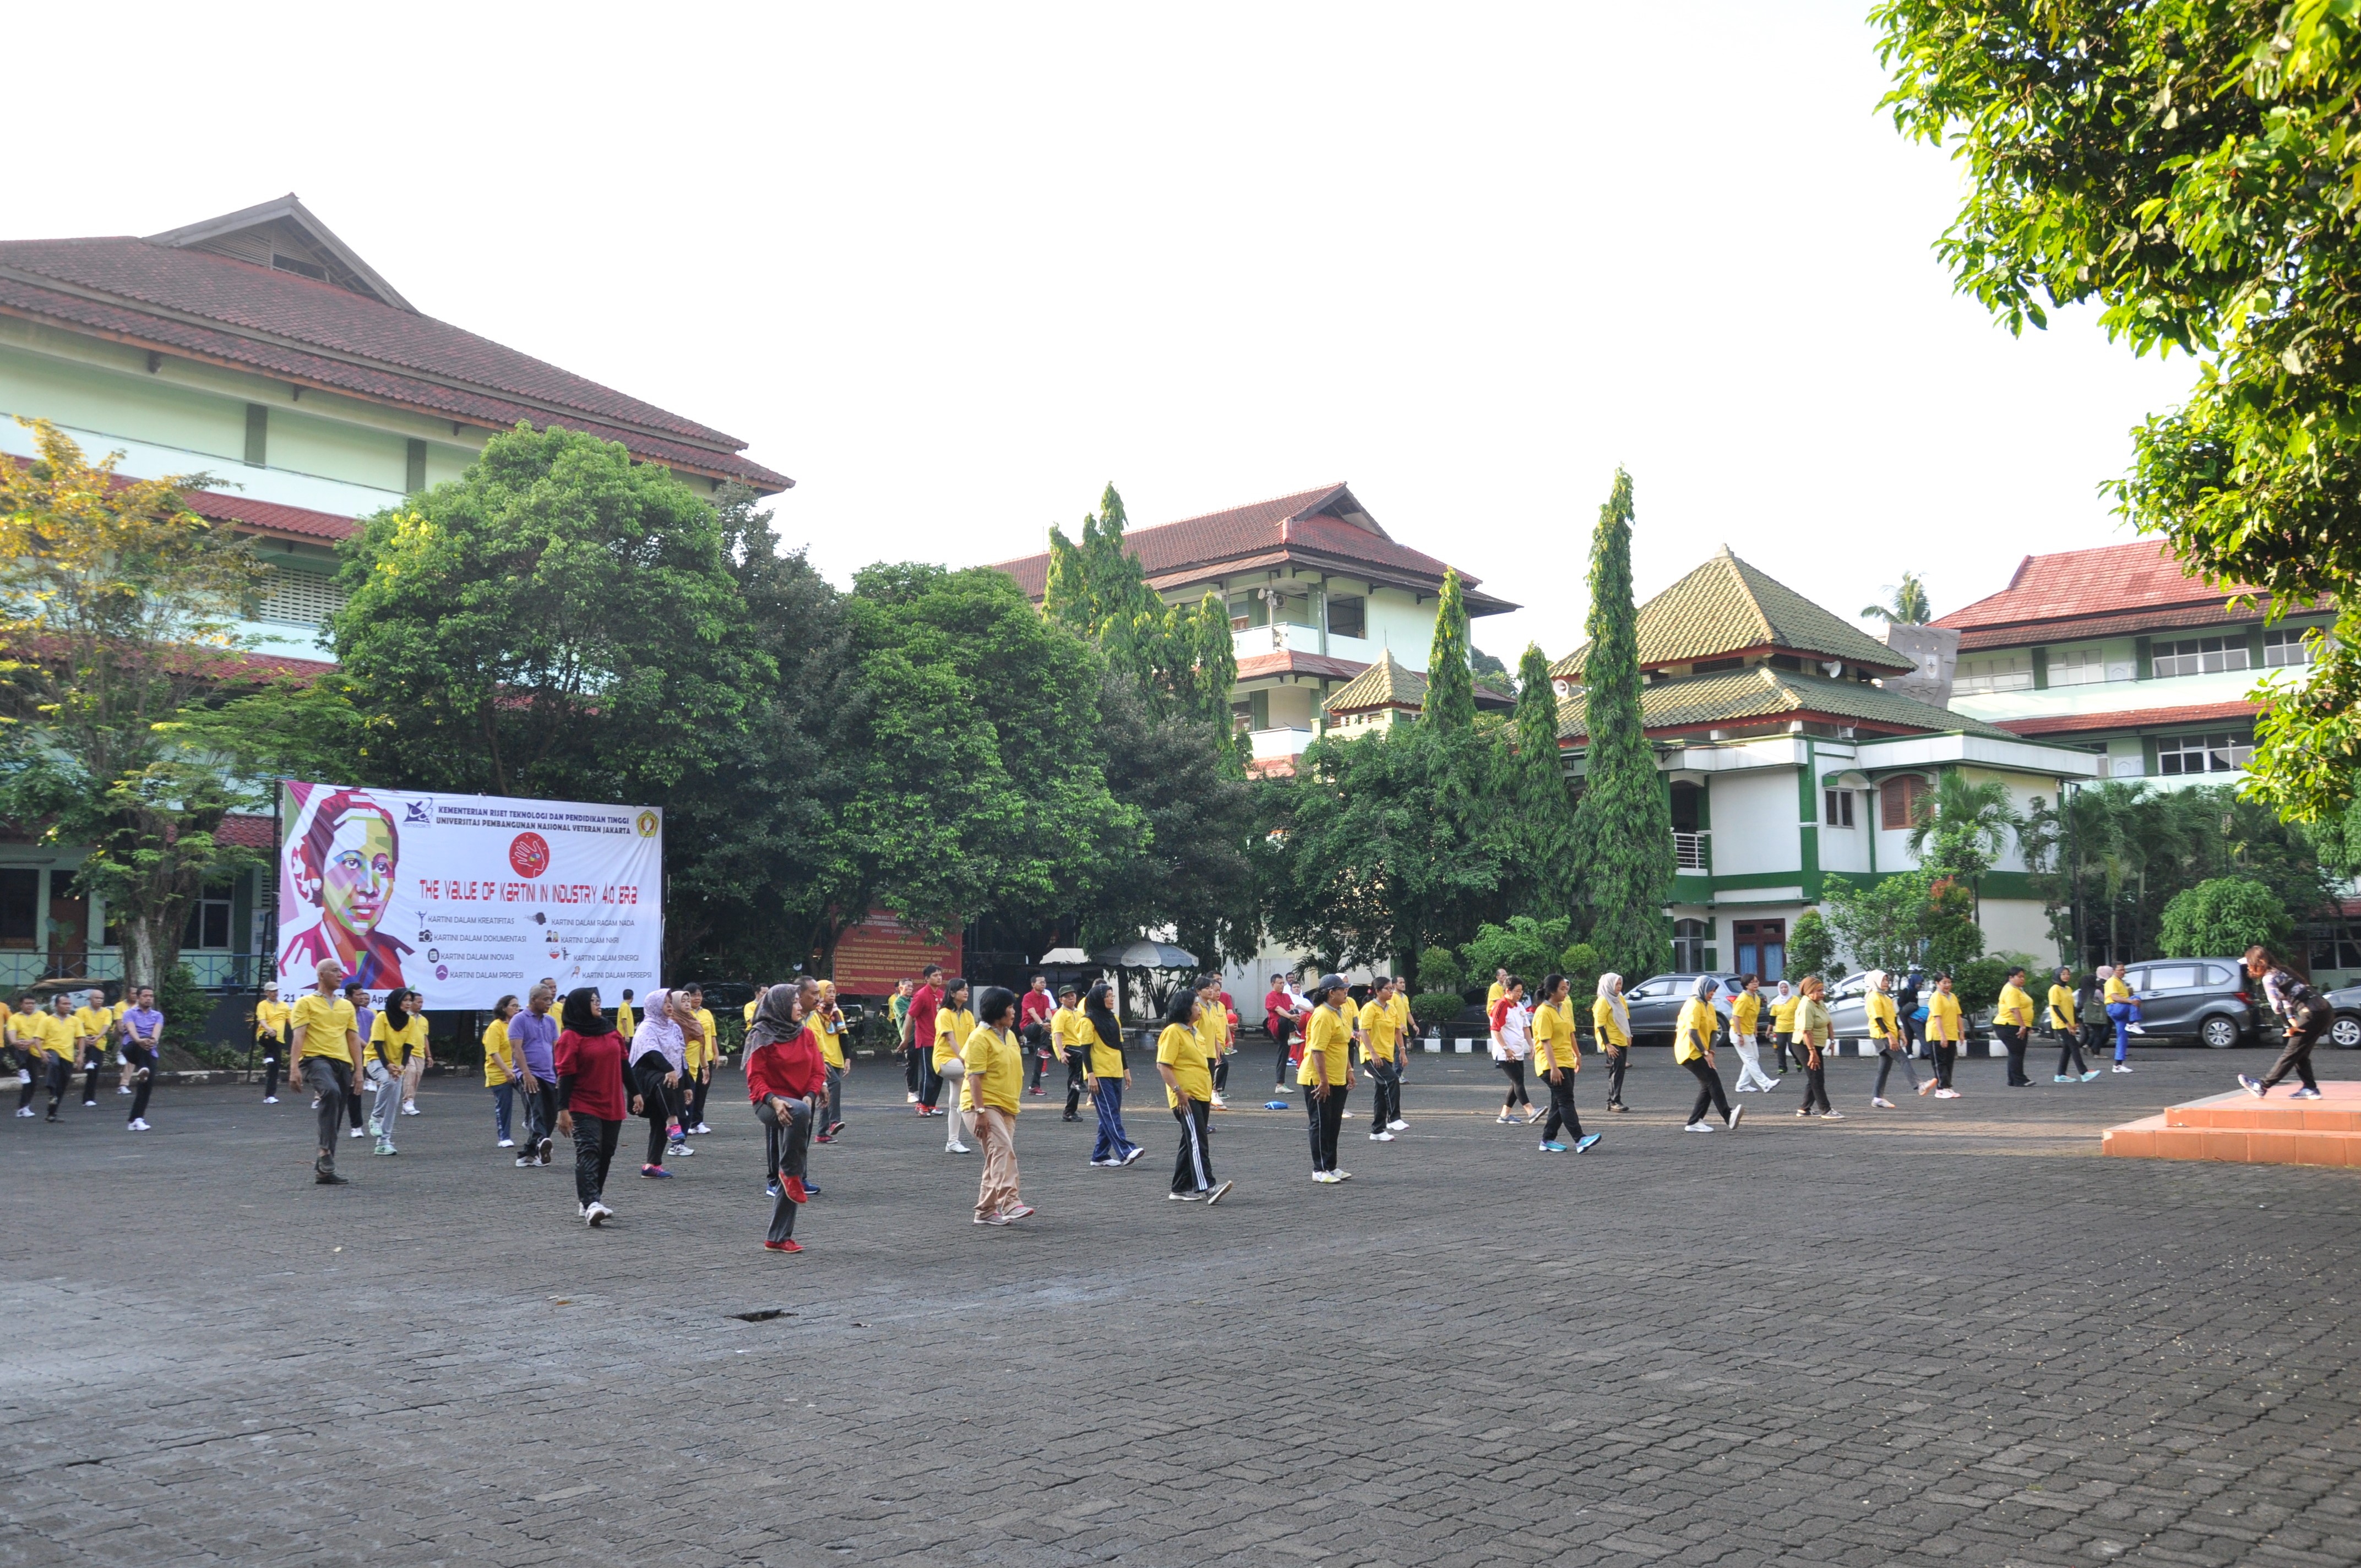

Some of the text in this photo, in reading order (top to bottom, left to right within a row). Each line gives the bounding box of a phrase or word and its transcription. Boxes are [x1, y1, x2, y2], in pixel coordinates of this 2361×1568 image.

[438, 806, 488, 815] KEMENTERIAN
[509, 810, 547, 819] TEKNOLOGI
[565, 814, 606, 823] PENDIDIKAN
[436, 817, 480, 826] UNIVERSITAS
[482, 820, 535, 829] PEMBANGUNAN
[572, 825, 601, 833] VETERAN
[420, 879, 439, 900] THE
[482, 881, 495, 901] OF
[540, 884, 548, 902] IN
[552, 884, 597, 904] INDUSTRY
[284, 994, 295, 1002] 21
